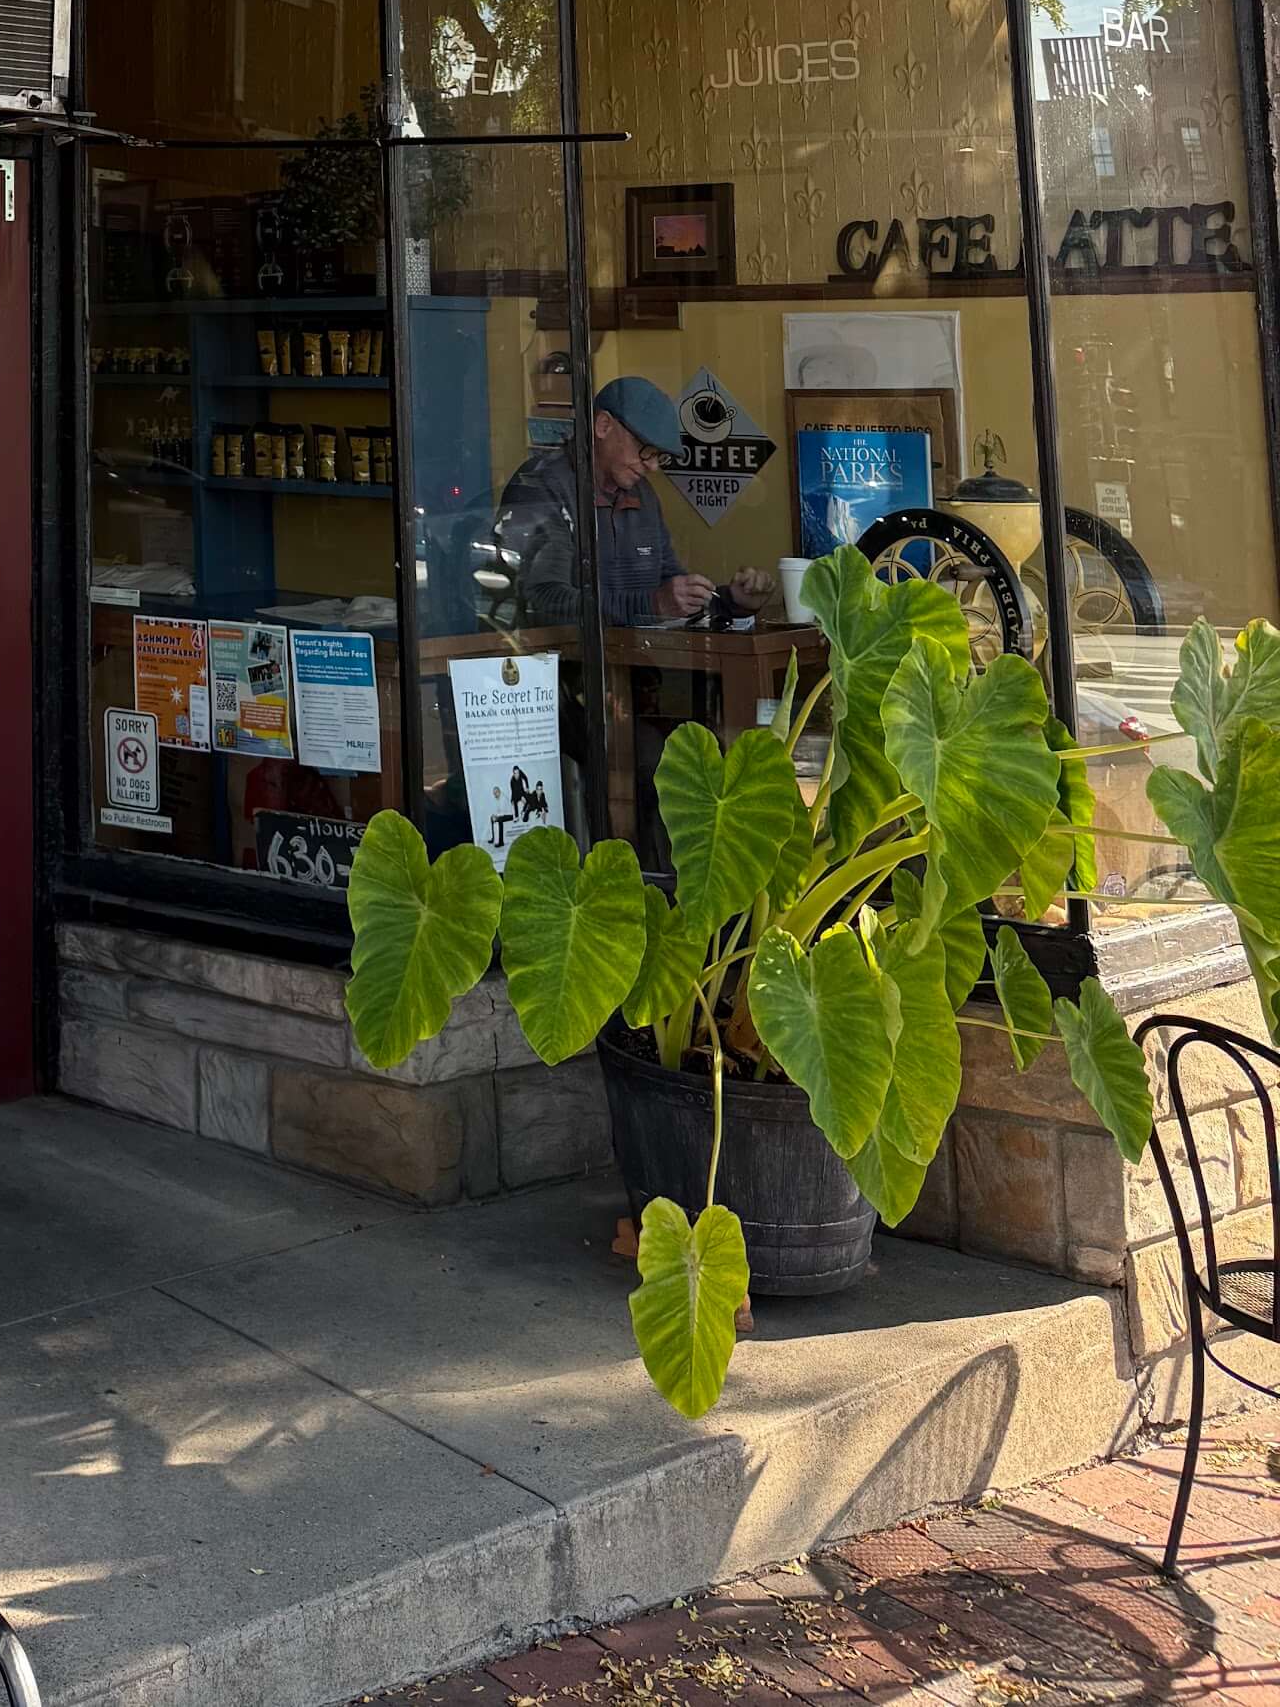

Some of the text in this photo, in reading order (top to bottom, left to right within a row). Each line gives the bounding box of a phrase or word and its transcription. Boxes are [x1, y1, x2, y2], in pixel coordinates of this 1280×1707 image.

[1102, 7, 1171, 53] BAR
[709, 39, 860, 89] JUICES
[836, 201, 1250, 278] CAFE ATTE
[662, 445, 758, 467] OFFEE
[821, 447, 902, 463] NATIONAL
[821, 461, 903, 484] PARKS
[688, 478, 740, 494] SERVED
[696, 495, 728, 507] RIGHT
[138, 634, 182, 646] ASHMONT
[462, 690, 487, 707] The
[492, 689, 531, 705] Secret
[465, 709, 498, 719] BALKAN
[115, 717, 149, 734] SORRY
[116, 776, 151, 790] NO DOGS
[116, 788, 151, 803] ALLOWED
[102, 811, 171, 829] No Public Restroom
